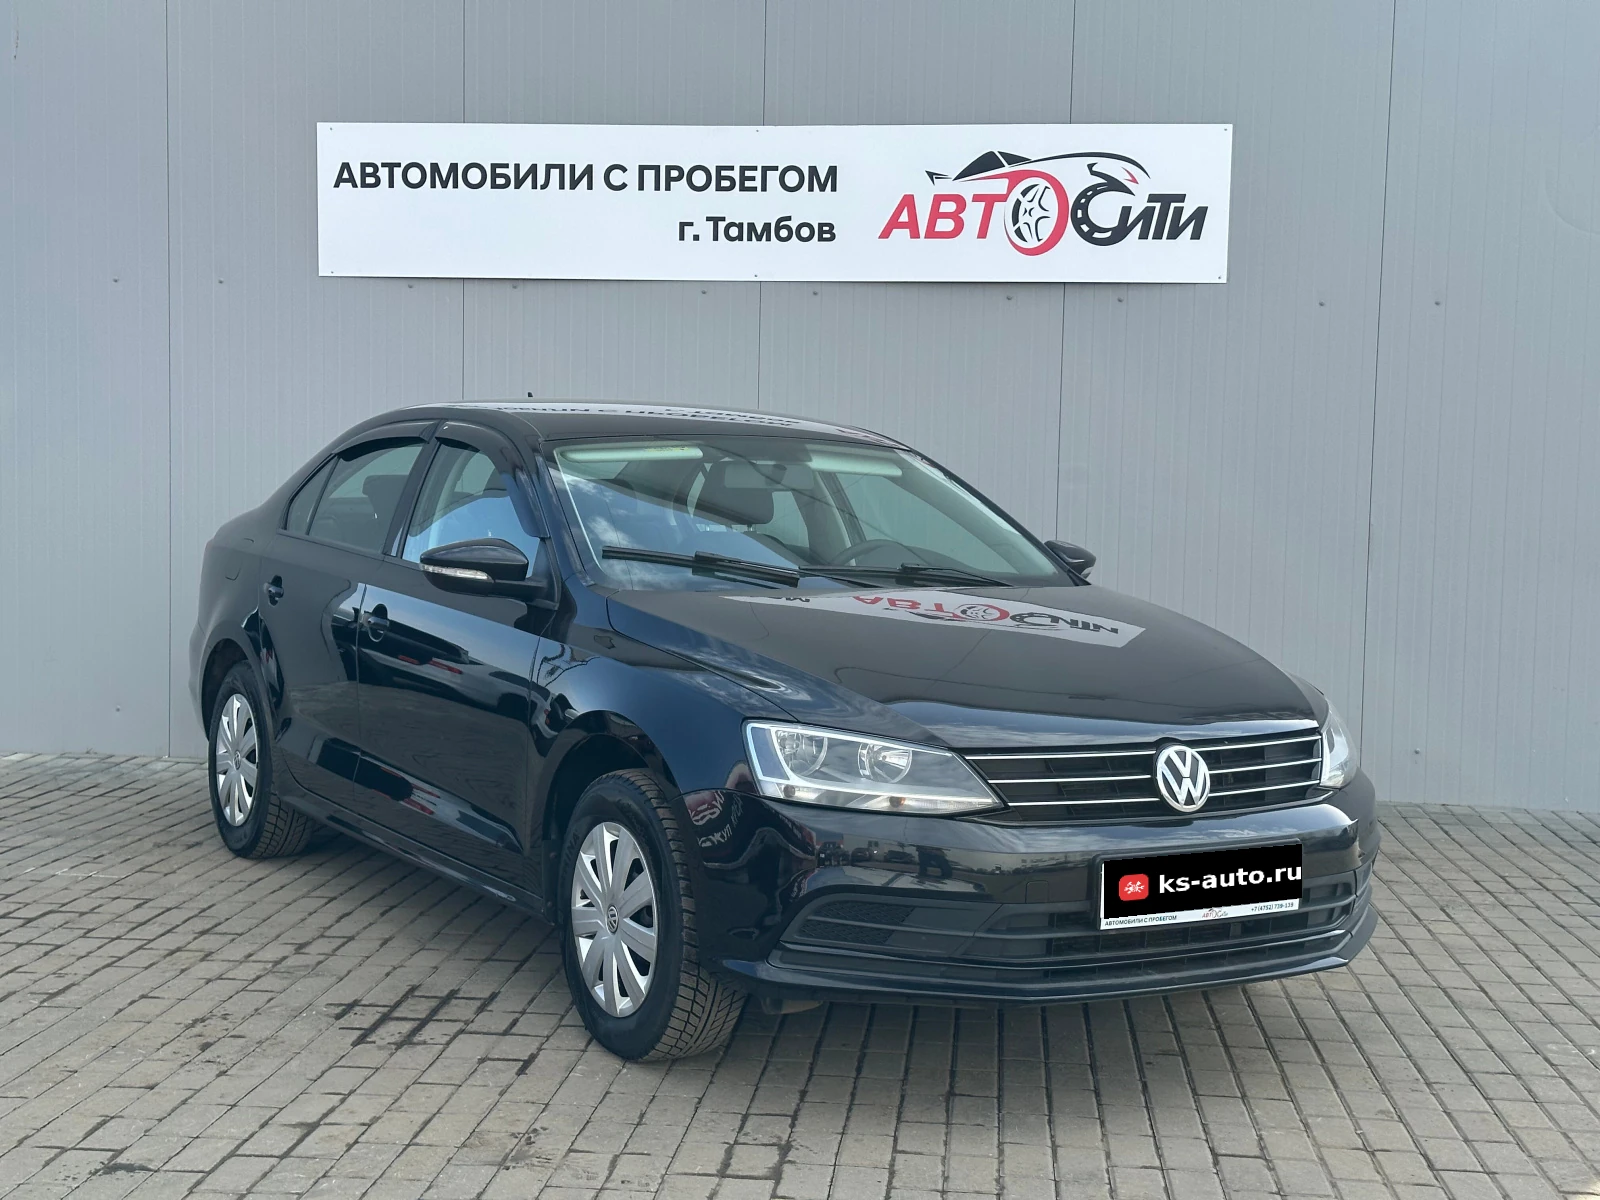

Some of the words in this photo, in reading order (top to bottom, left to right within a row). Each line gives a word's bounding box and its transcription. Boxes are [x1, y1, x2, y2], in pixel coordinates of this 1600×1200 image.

[333, 161, 594, 191] АВТОМОБИЛИ
[603, 163, 628, 192] С
[637, 165, 838, 193] ПРОБЕГОМ
[678, 221, 700, 242] г.
[705, 216, 837, 243] Тамбов
[1104, 918, 1143, 926] АВТОМОБИЛИ
[1148, 915, 1178, 923] ПРОБЕГОМ
